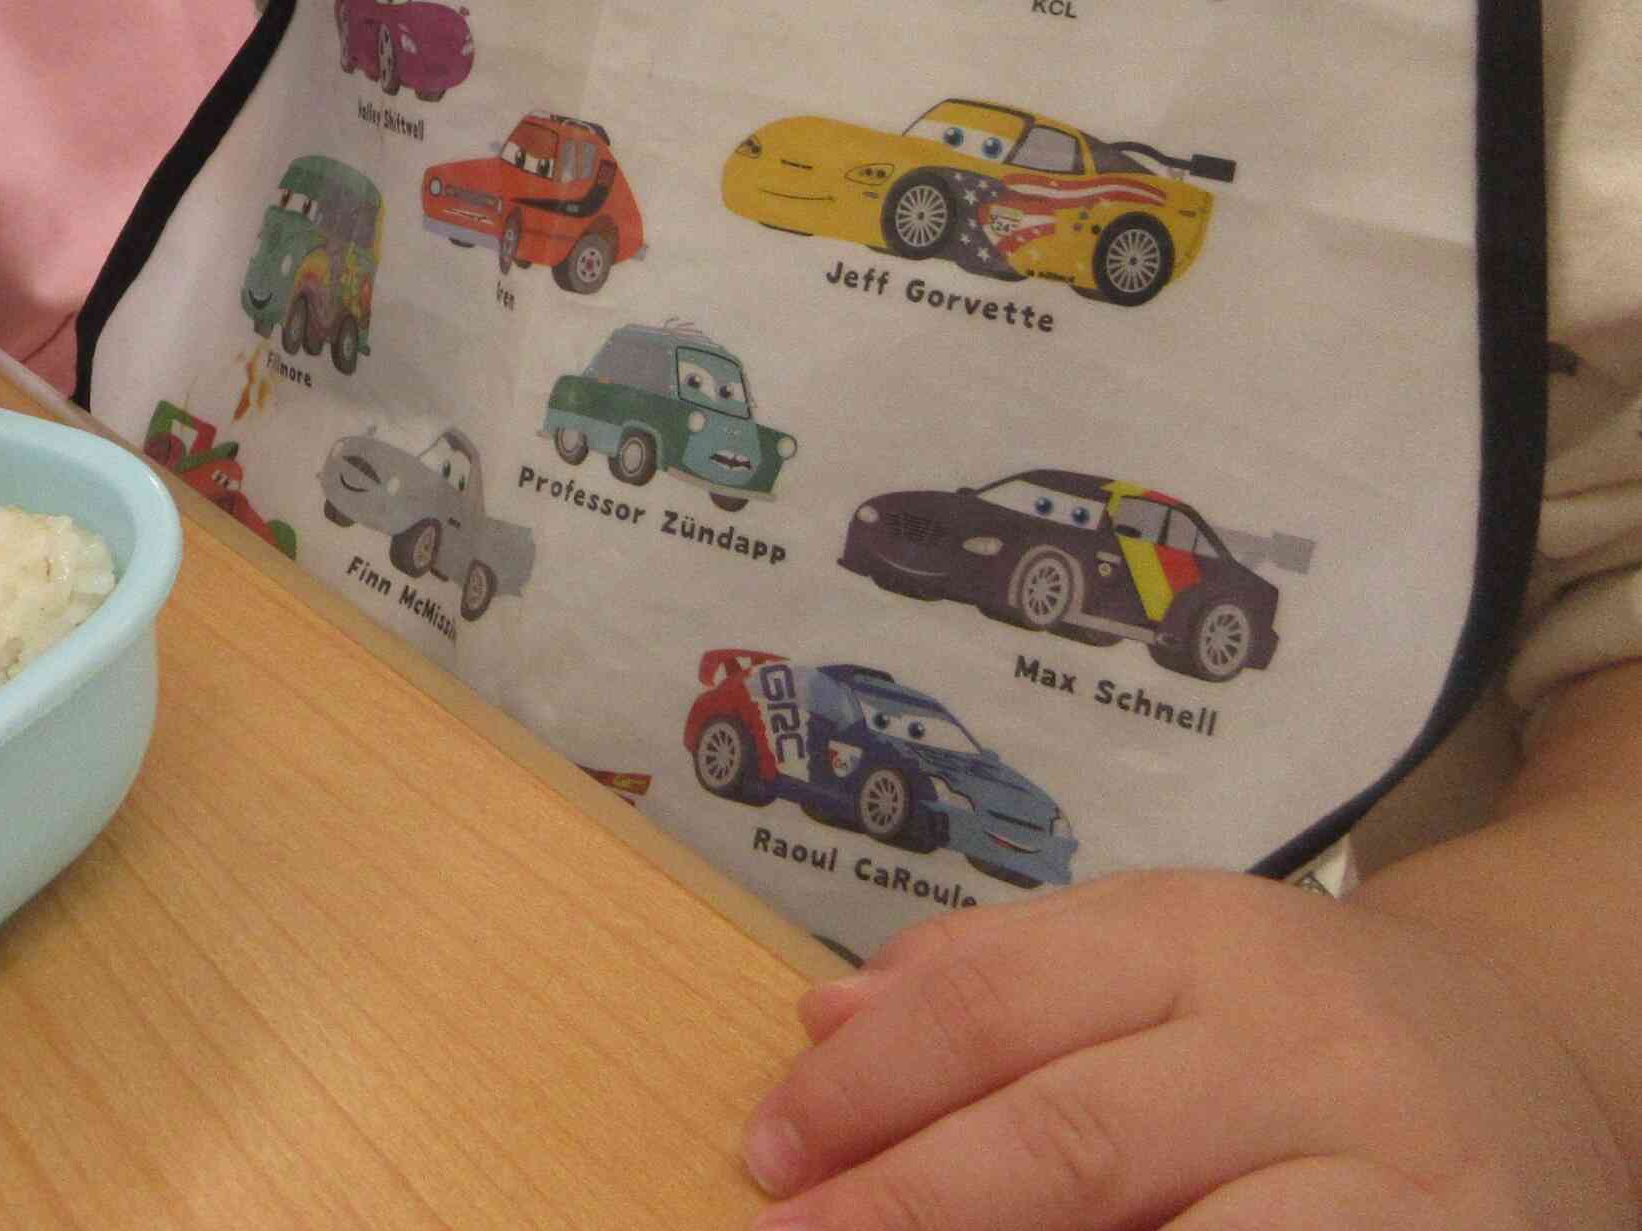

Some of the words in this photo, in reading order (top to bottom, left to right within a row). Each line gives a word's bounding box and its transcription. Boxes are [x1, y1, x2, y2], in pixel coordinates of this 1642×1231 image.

[825, 261, 890, 296] Jeff
[905, 278, 1055, 333] Gorvette
[517, 465, 647, 524] Professor
[660, 509, 787, 566] Zündapp
[346, 555, 392, 596] Finn
[1013, 654, 1077, 695] Max
[1093, 679, 1218, 737] Schnell
[752, 826, 839, 873] Raoul
